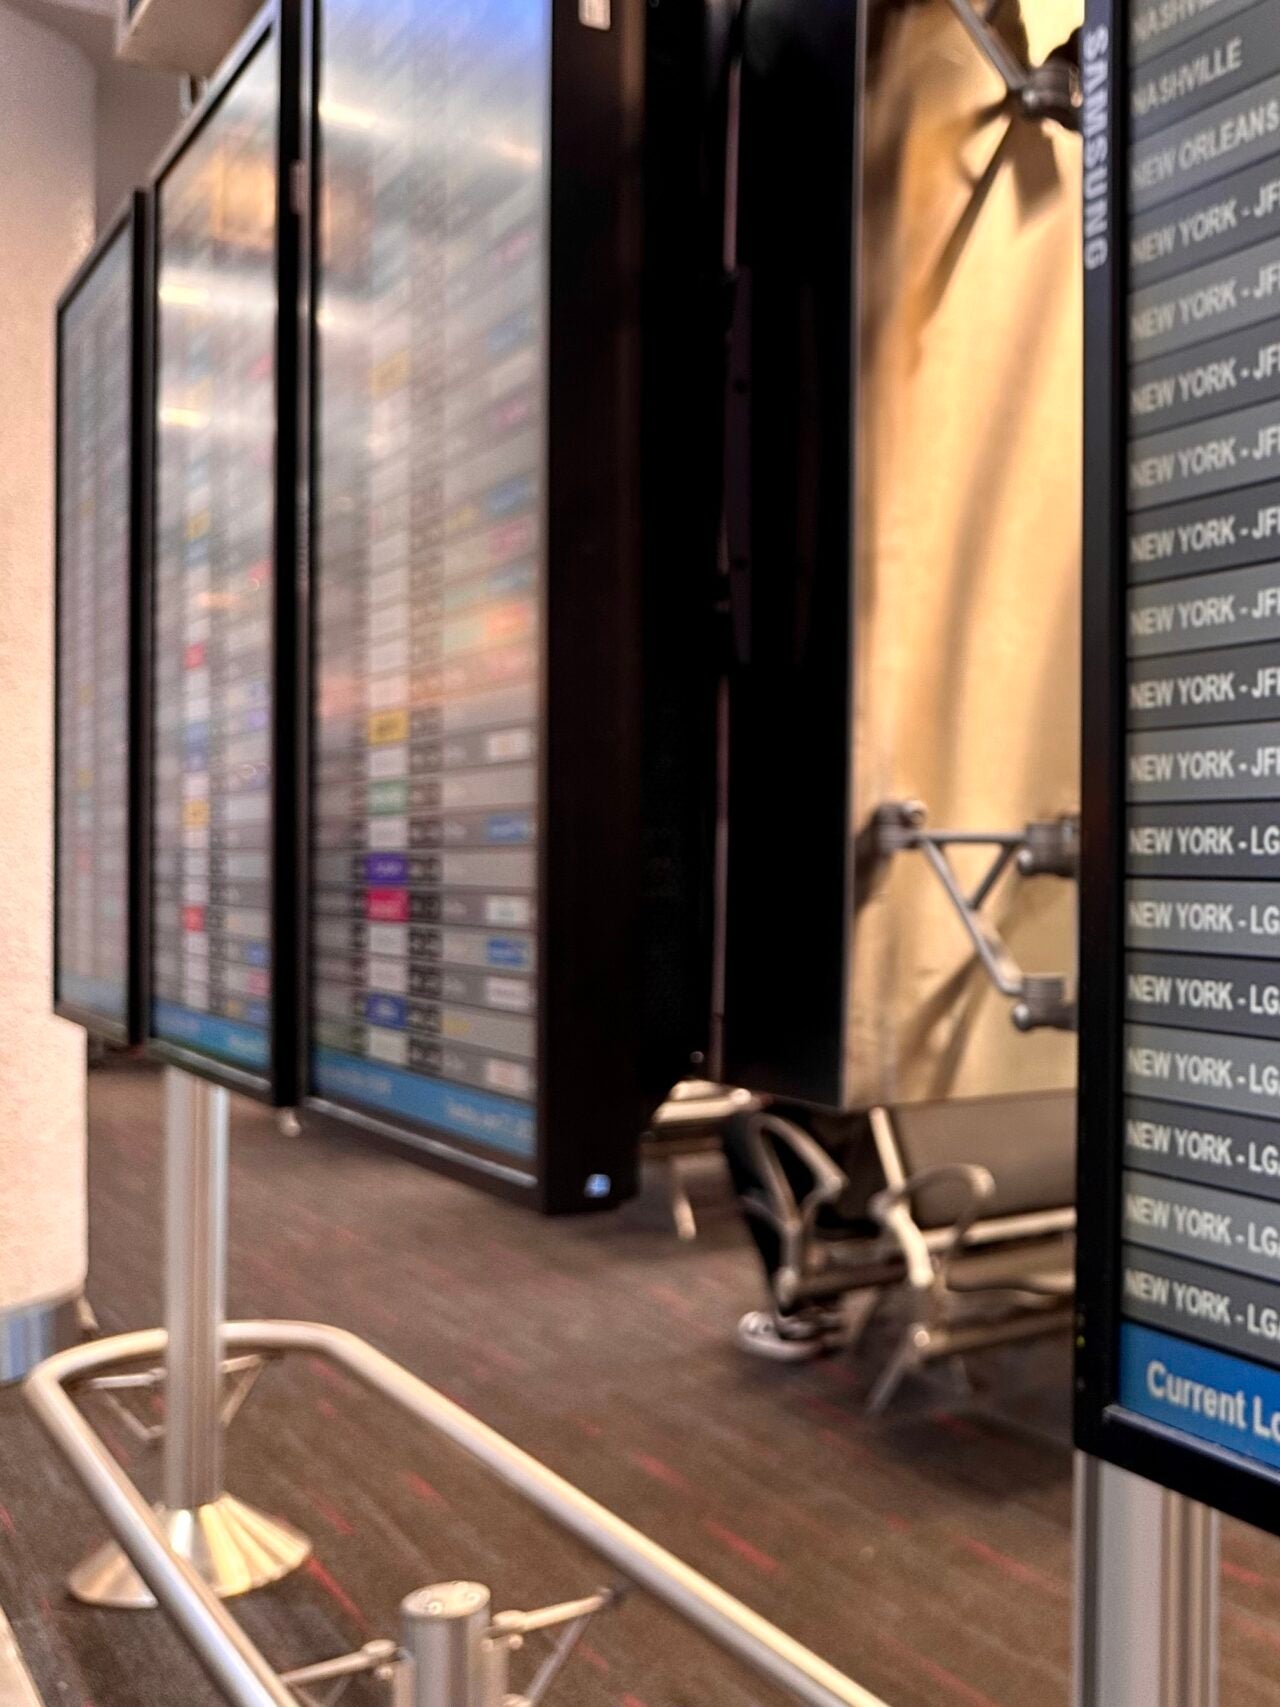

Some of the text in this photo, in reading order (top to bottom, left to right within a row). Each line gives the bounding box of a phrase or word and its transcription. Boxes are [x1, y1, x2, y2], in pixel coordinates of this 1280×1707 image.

[1134, 36, 1242, 115] NASHVILLE
[1084, 25, 1109, 267] SAMSUNG
[1133, 147, 1176, 190] NEW
[1179, 99, 1279, 171] ORLEANS
[1133, 225, 1176, 262] NEW
[1179, 200, 1237, 244] YORK
[1134, 302, 1176, 338] NEW
[1179, 279, 1237, 322] YORK
[1133, 378, 1176, 413] NEW
[1178, 358, 1237, 400] YORK
[1134, 453, 1175, 487] NEW
[1178, 437, 1236, 475] YORK
[1132, 529, 1175, 561] NEW
[1178, 515, 1235, 552] YORK
[1132, 605, 1175, 635] NEW
[1178, 595, 1236, 628] YORK
[1131, 680, 1174, 709] NEW
[1178, 672, 1235, 704] YORK
[1132, 754, 1174, 782] NEW
[1177, 749, 1235, 780] YORK
[1131, 827, 1173, 855] NEW
[1177, 826, 1234, 855] YORK
[1131, 901, 1173, 928] NEW
[1176, 903, 1234, 932] YORK
[1130, 975, 1172, 1004] NEW
[1176, 979, 1233, 1011] YORK
[1129, 1048, 1172, 1079] NEW
[1175, 1054, 1233, 1089] YORK
[1128, 1122, 1171, 1153] NEW
[1174, 1129, 1233, 1166] YORK
[1128, 1196, 1171, 1228] NEW
[1174, 1205, 1232, 1245] YORK
[1127, 1271, 1170, 1305] NEW
[1174, 1282, 1231, 1325] YORK
[1147, 1360, 1247, 1430] Current
